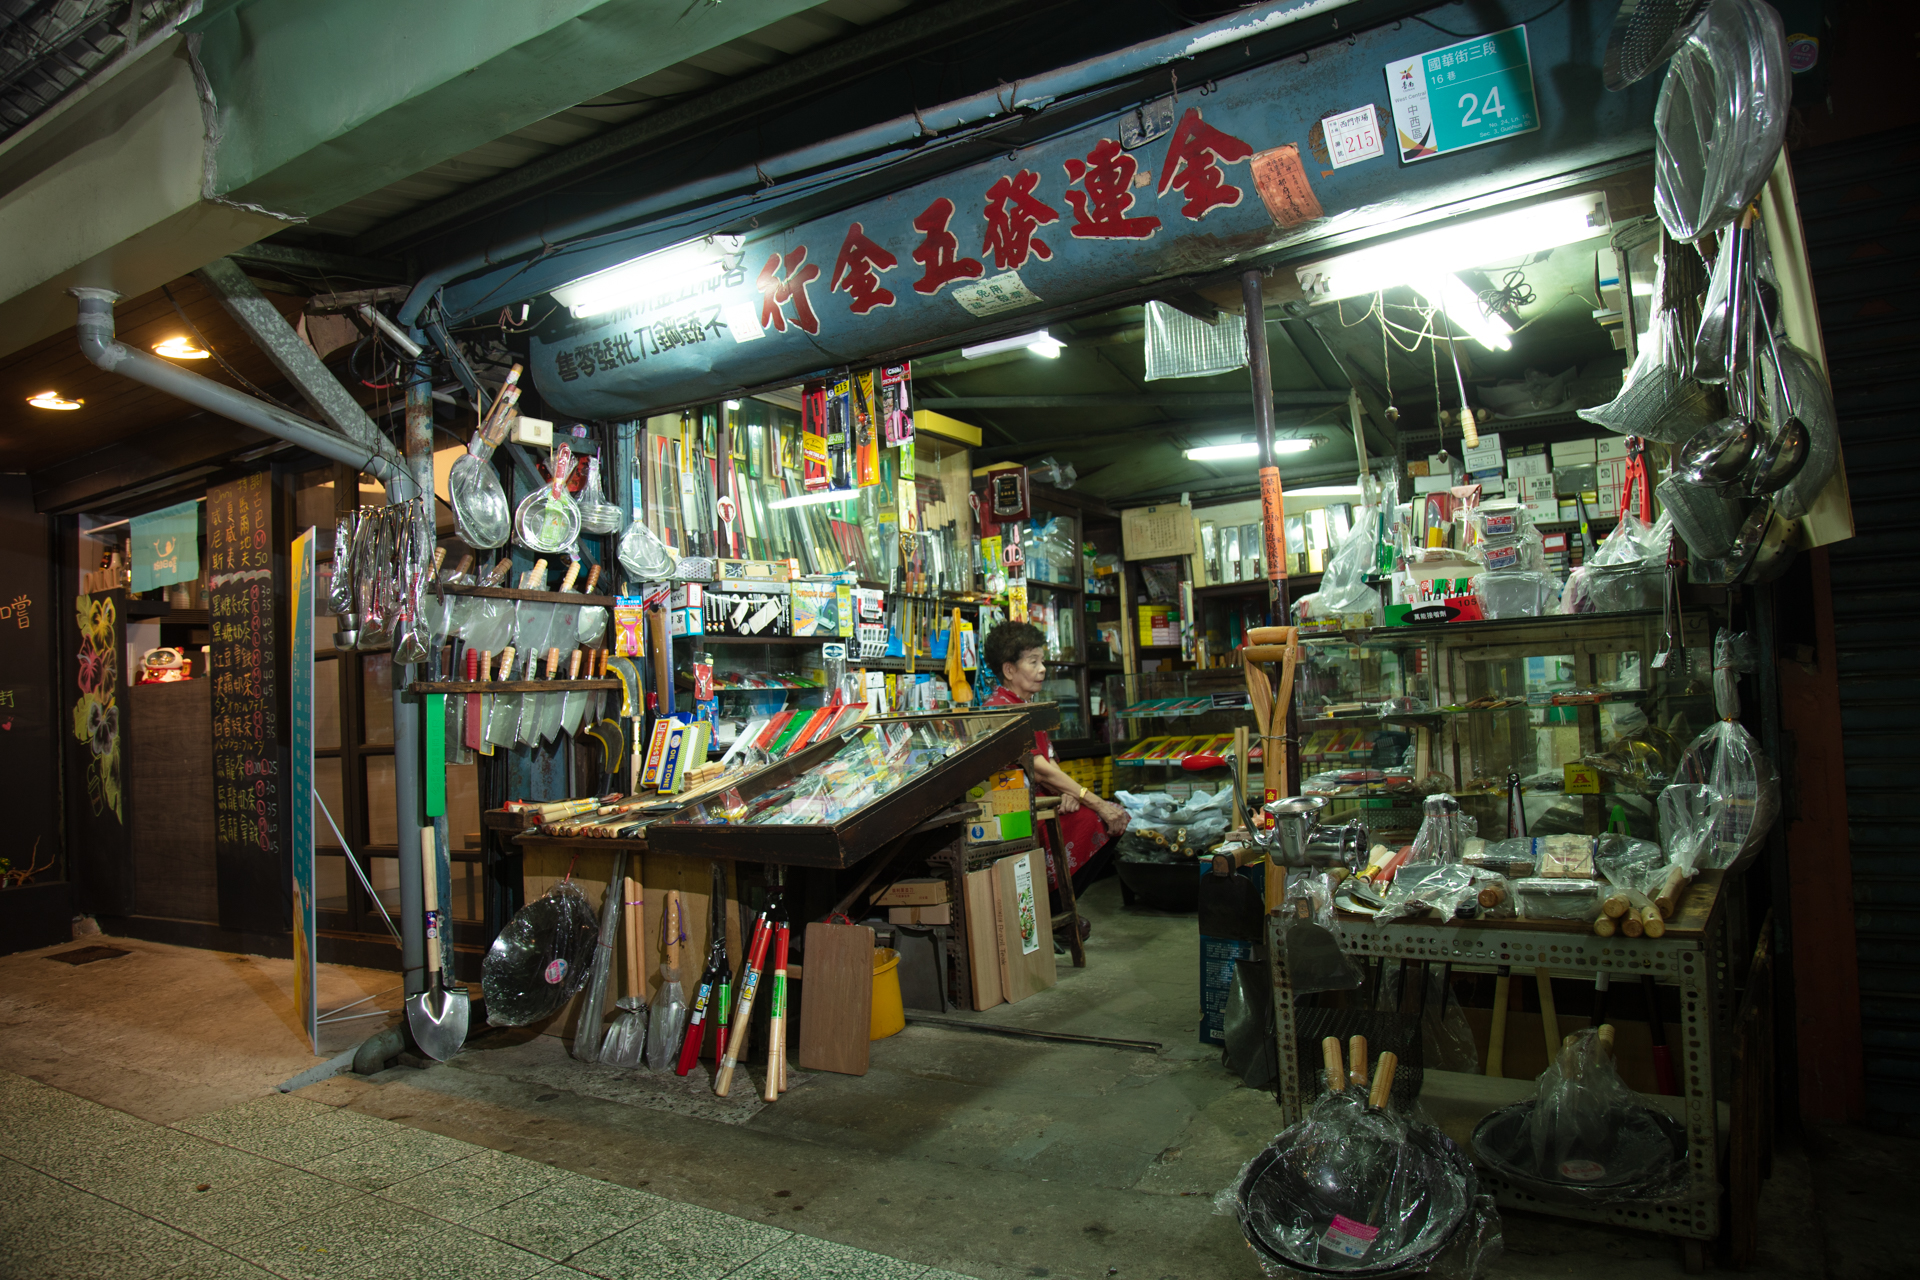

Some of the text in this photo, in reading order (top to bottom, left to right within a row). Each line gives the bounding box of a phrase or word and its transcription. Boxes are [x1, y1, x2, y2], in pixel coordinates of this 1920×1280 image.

[1428, 41, 1497, 72] 國華街三段
[1431, 74, 1444, 85] 16
[1408, 90, 1426, 100] Central
[1458, 86, 1506, 127] 24
[1340, 113, 1368, 128] 西門市場
[1408, 104, 1422, 140] 中西區
[1500, 123, 1523, 134] Guohua
[1346, 130, 1374, 153] 215
[755, 106, 1254, 337] 金連發五金行
[976, 284, 1003, 298] 免用
[556, 304, 728, 382] 不銹鋼刀批發零售
[836, 383, 848, 393] 215
[254, 491, 265, 529] 古巴
[210, 508, 224, 570] 威尼斯
[226, 500, 236, 569] 夏威夷
[254, 552, 268, 567] 50
[212, 589, 250, 617] 黑糖紅茶
[1458, 598, 1477, 607] 105
[212, 620, 251, 644] 黑糖奶茶
[214, 714, 252, 737] 百香綠茶
[653, 732, 663, 755] STONE
[663, 764, 673, 788] STONE
[1573, 774, 1590, 783] A
